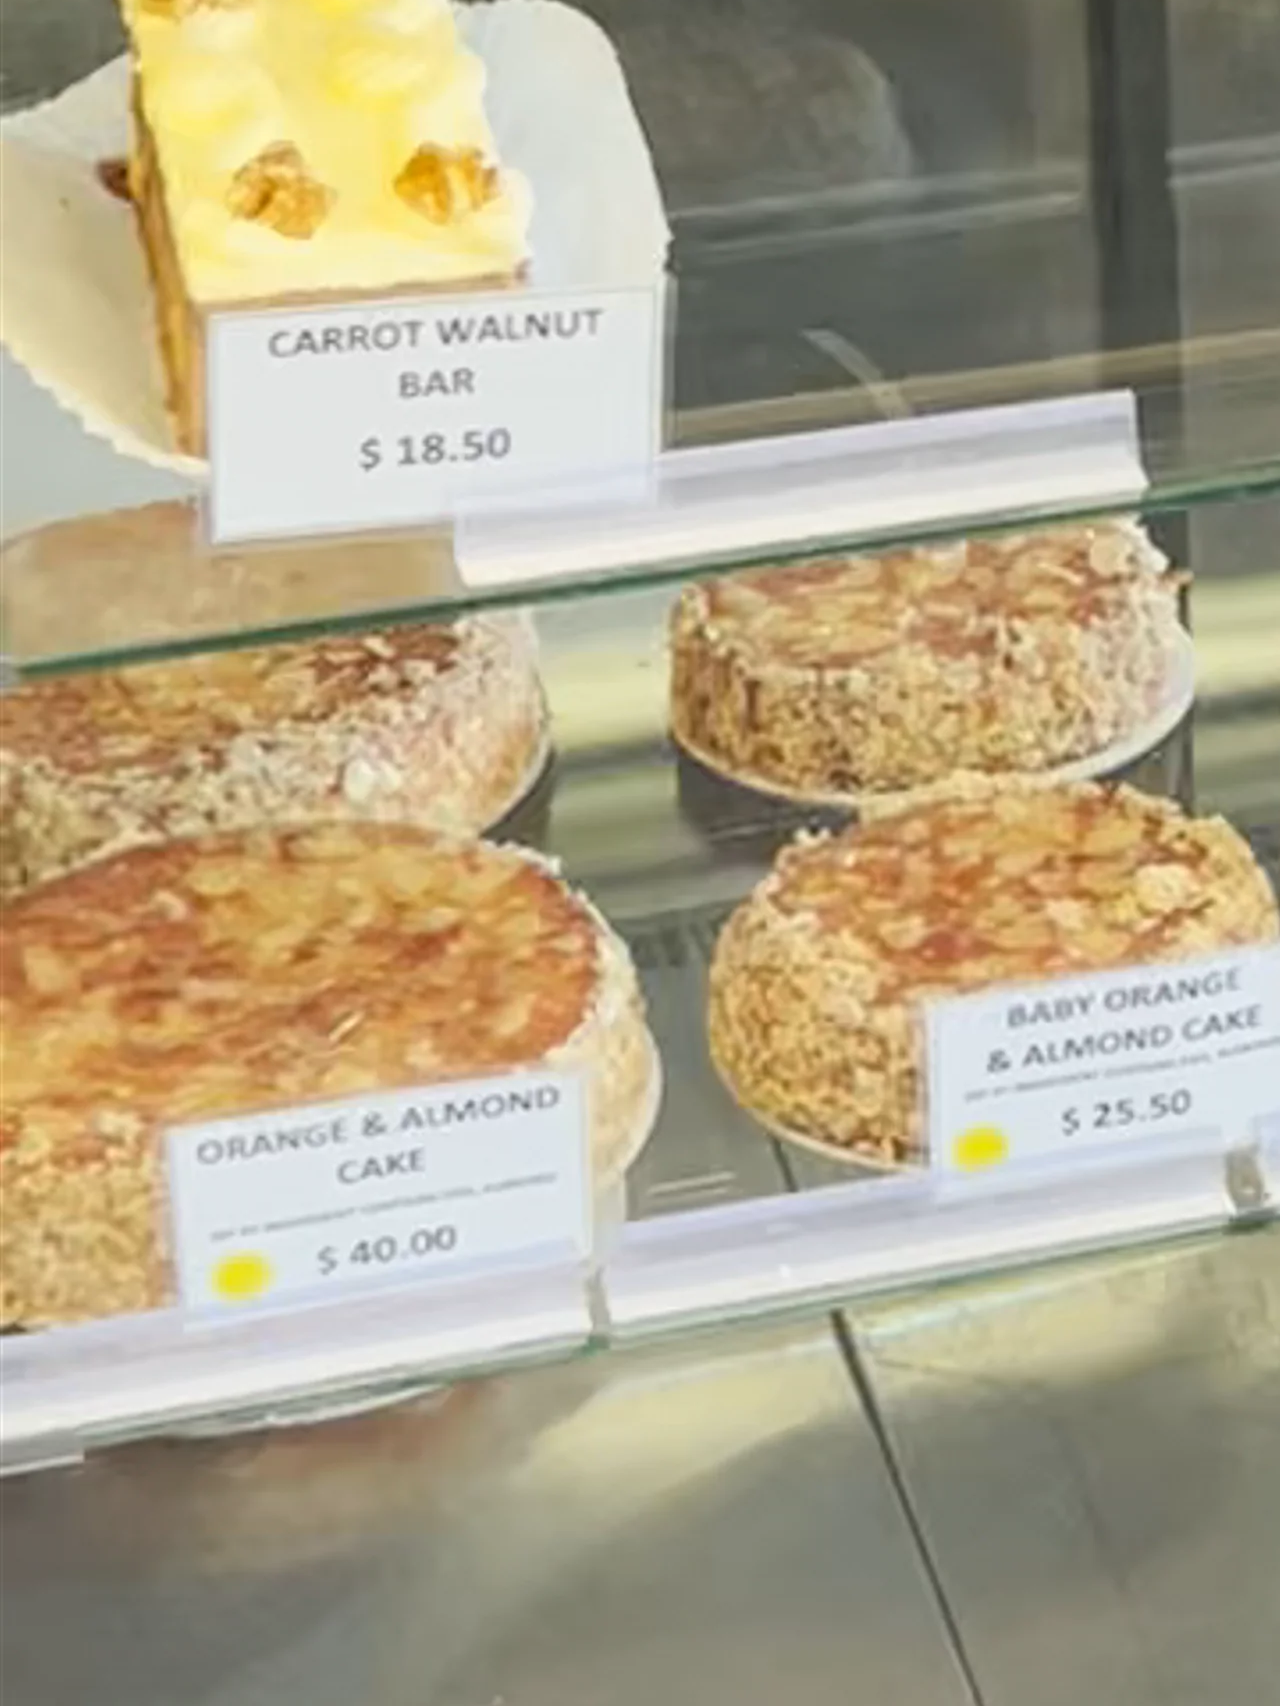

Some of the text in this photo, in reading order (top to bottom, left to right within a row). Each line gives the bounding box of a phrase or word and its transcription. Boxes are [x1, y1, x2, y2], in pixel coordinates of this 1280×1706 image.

[267, 307, 604, 359] CARROT WALNUT
[398, 367, 476, 400] BAR
[359, 426, 511, 472] $ 18.50
[1007, 967, 1243, 1030] BABY ORANGE
[986, 1049, 1012, 1075] &
[1022, 1023, 1174, 1068] ALMOND
[1182, 1005, 1263, 1042] CAKE
[196, 1084, 560, 1166] ORANGE & ALMOND
[1061, 1089, 1193, 1136] $ 25.50
[336, 1147, 427, 1185] CAKE
[316, 1224, 458, 1276] $ 40.00
